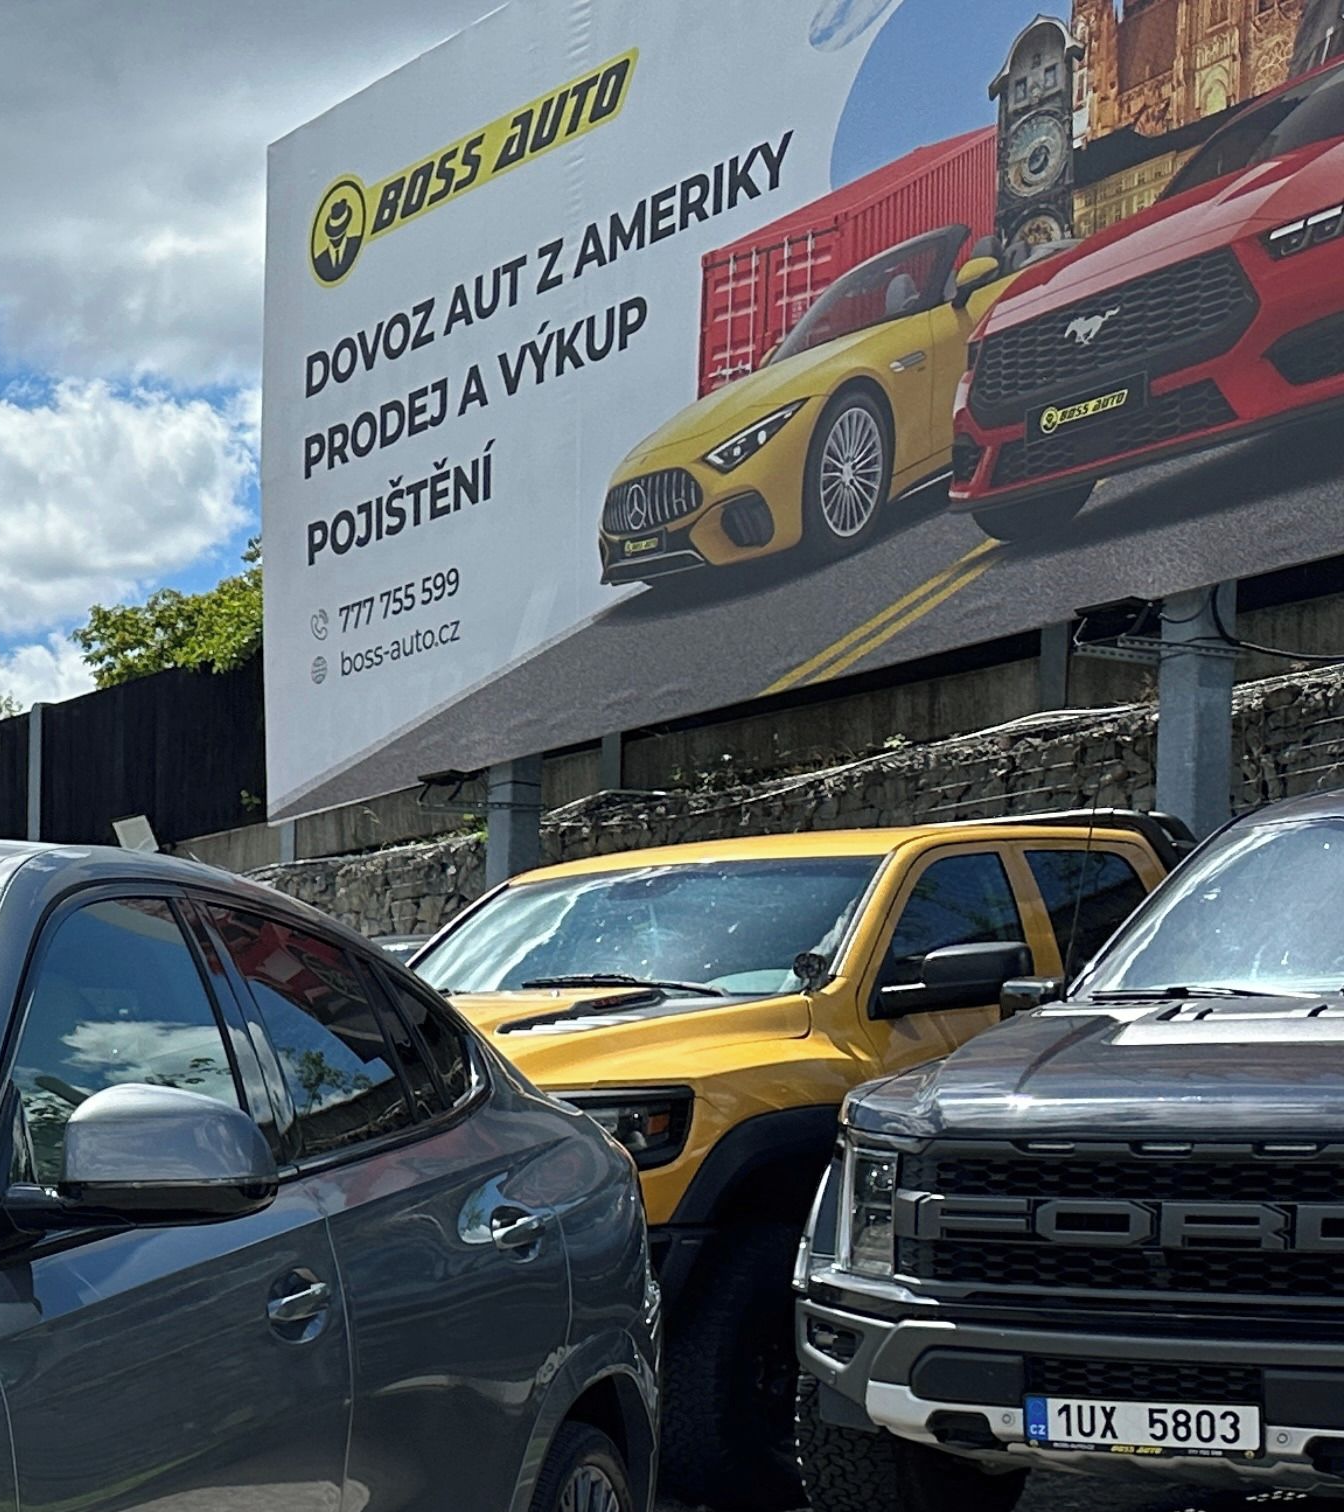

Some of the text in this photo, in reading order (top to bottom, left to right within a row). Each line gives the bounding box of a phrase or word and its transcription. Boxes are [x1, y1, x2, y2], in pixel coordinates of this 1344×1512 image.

[371, 59, 630, 235] BOSS AUTO
[305, 130, 794, 398] DOVOZ AUT Z AMERIKY
[304, 297, 647, 480] PRODEJ A VÝKUP
[308, 439, 495, 566] POJIŠTĚNÍ
[338, 568, 460, 632] 777 755 599
[340, 620, 461, 677] boss-auto.cz
[1030, 1424, 1046, 1436] CZ
[1057, 1404, 1240, 1444] 1UX 5803
